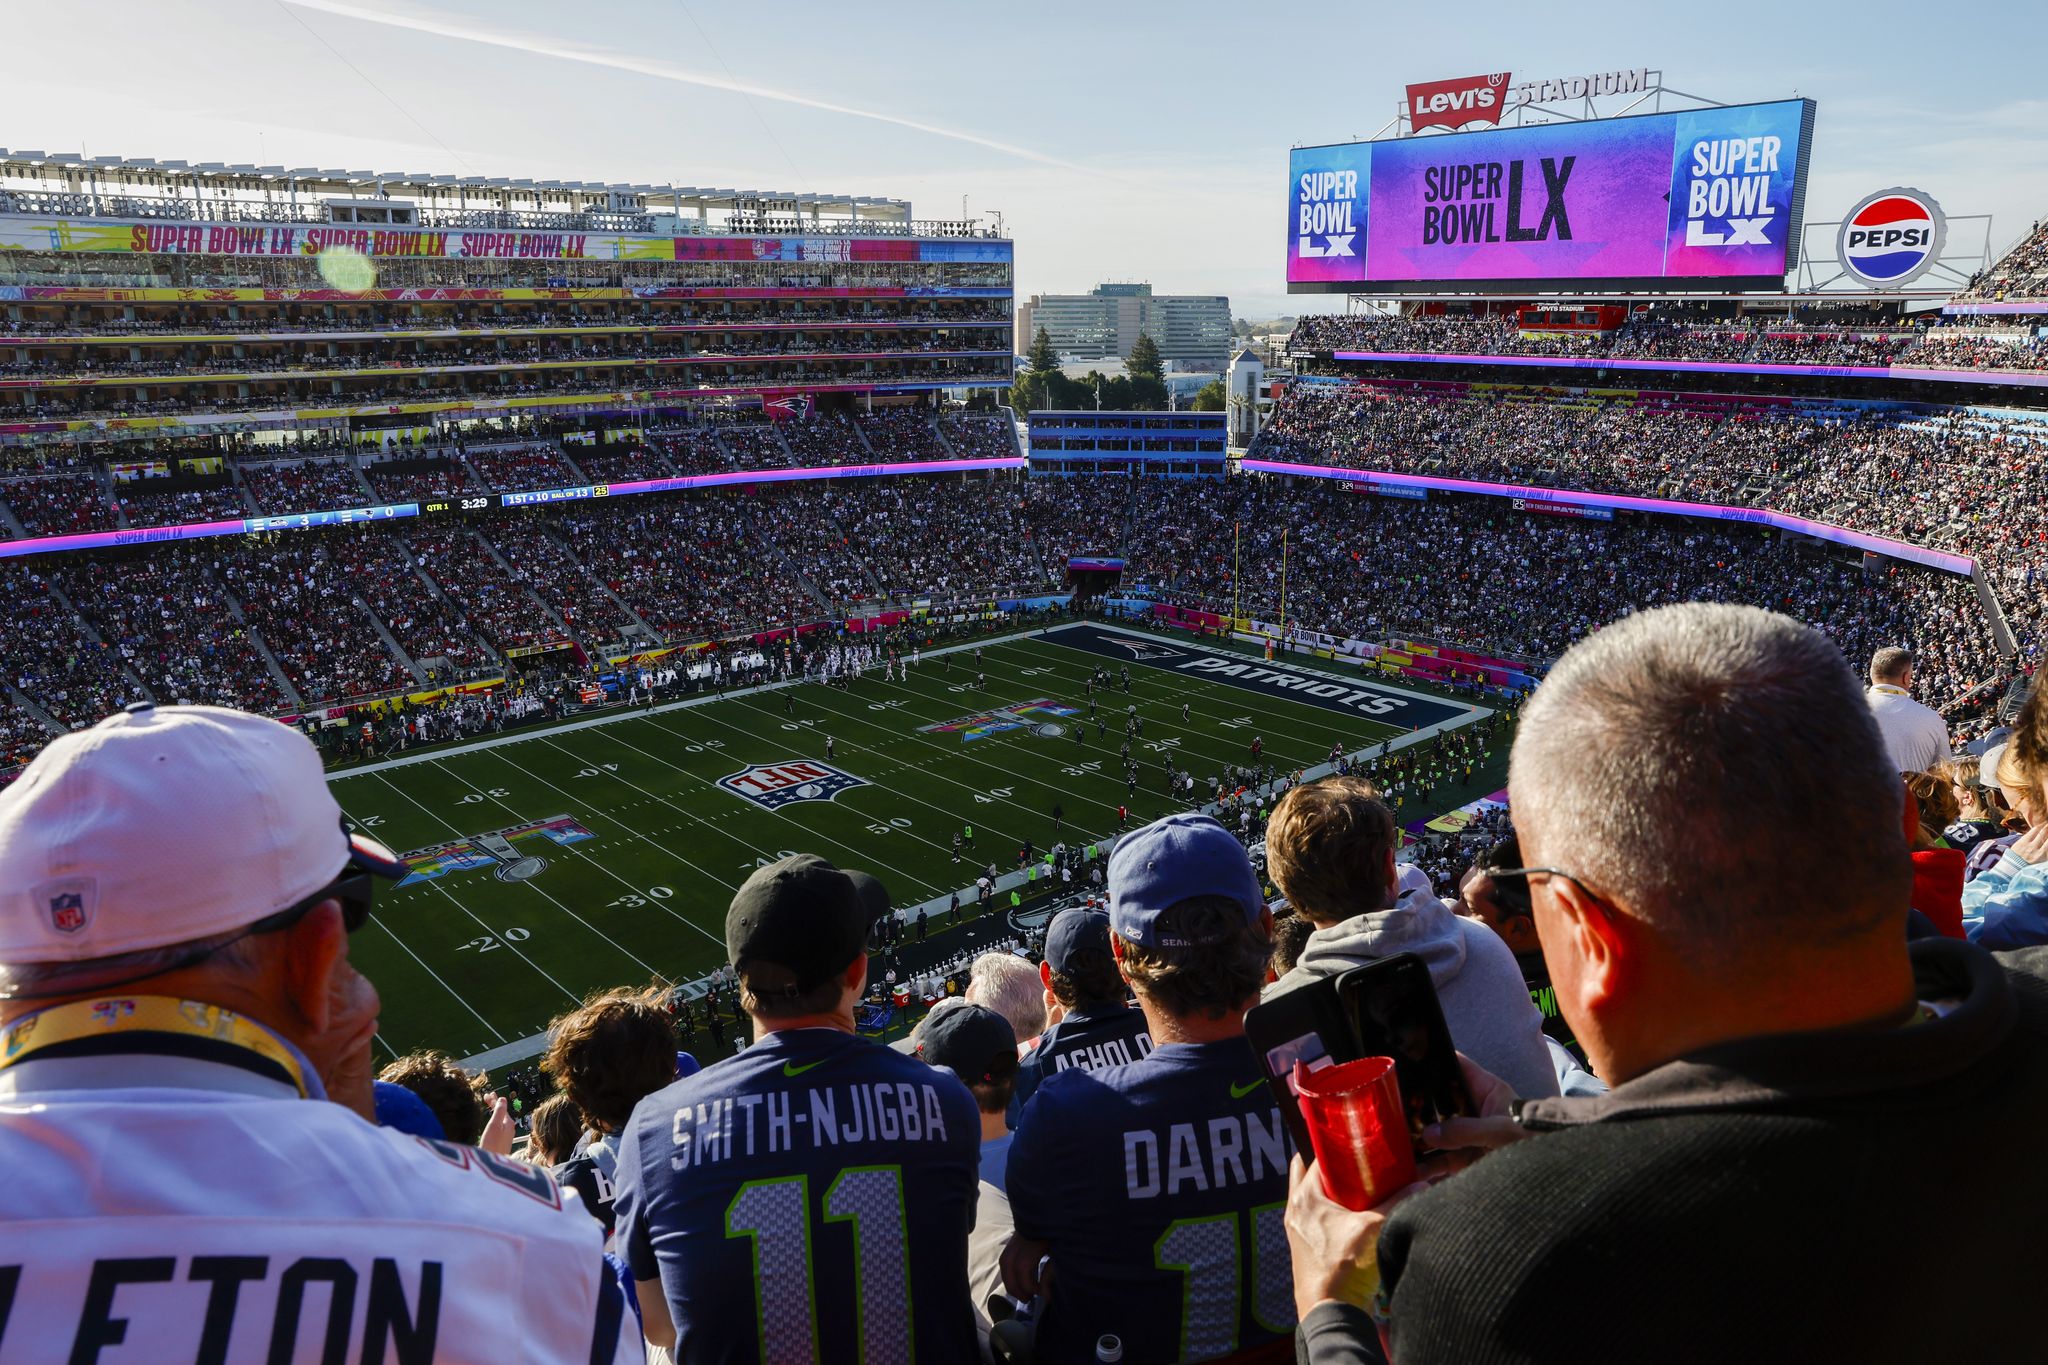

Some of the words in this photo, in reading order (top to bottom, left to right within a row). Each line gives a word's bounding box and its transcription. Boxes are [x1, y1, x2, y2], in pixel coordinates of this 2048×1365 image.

[1514, 68, 1648, 106] STADIUM
[1692, 136, 1781, 177] SUPER
[1300, 170, 1358, 202] SUPER
[1424, 163, 1502, 202] SUPER
[1505, 156, 1577, 242] LX
[1687, 177, 1776, 218] BOWL
[1299, 201, 1356, 235] BOWL
[1423, 202, 1501, 245] BOWL
[130, 223, 203, 253] SUPER
[208, 226, 264, 254] BOWL
[270, 228, 295, 255] LX
[306, 228, 368, 255] SUPER
[373, 230, 422, 256] BOWL
[427, 232, 448, 257] LX
[1685, 217, 1773, 247] LX
[1848, 228, 1930, 249] PEPSI
[460, 232, 515, 258] SUPER
[518, 234, 562, 258] BOWL
[567, 235, 587, 259] LX
[1298, 234, 1356, 258] LX
[509, 495, 527, 504] 1ST
[536, 492, 549, 502] 10
[551, 492, 566, 500] BALL
[566, 491, 574, 499] ON
[576, 489, 588, 498] 13
[594, 487, 607, 496] 25
[1368, 486, 1424, 497] SEAHAWKS
[1505, 487, 1526, 498] SUPER
[1527, 489, 1545, 499] BOWL
[1545, 491, 1555, 500] LX
[385, 507, 394, 517] 0
[426, 504, 442, 512] QTR
[461, 498, 488, 509] 3:29
[1514, 500, 1525, 509] 25
[1552, 505, 1612, 518] PATRIOTS
[300, 516, 309, 525] 3
[1719, 508, 1745, 521] SUPER
[1746, 509, 1766, 523] BOWL
[115, 531, 144, 544] SUPER
[146, 528, 171, 542] BOWL
[172, 527, 183, 539] LX
[1300, 631, 1317, 643] BOWL
[1176, 657, 1409, 715] PATRIOTS
[1218, 716, 1253, 728] 10
[684, 740, 726, 753] 50
[1143, 738, 1182, 752] 20
[581, 762, 619, 777] 40
[728, 763, 831, 792] NFL
[1061, 761, 1101, 776] 30
[463, 788, 511, 803] 30
[973, 788, 1012, 804] 40
[468, 819, 547, 843] SUPER
[865, 817, 912, 835] 50
[619, 886, 674, 908] 30
[469, 927, 531, 953] 20
[671, 1082, 948, 1171] SMITH-NJIGBA
[1123, 1106, 1297, 1199] DARN
[725, 1164, 913, 1365] 11
